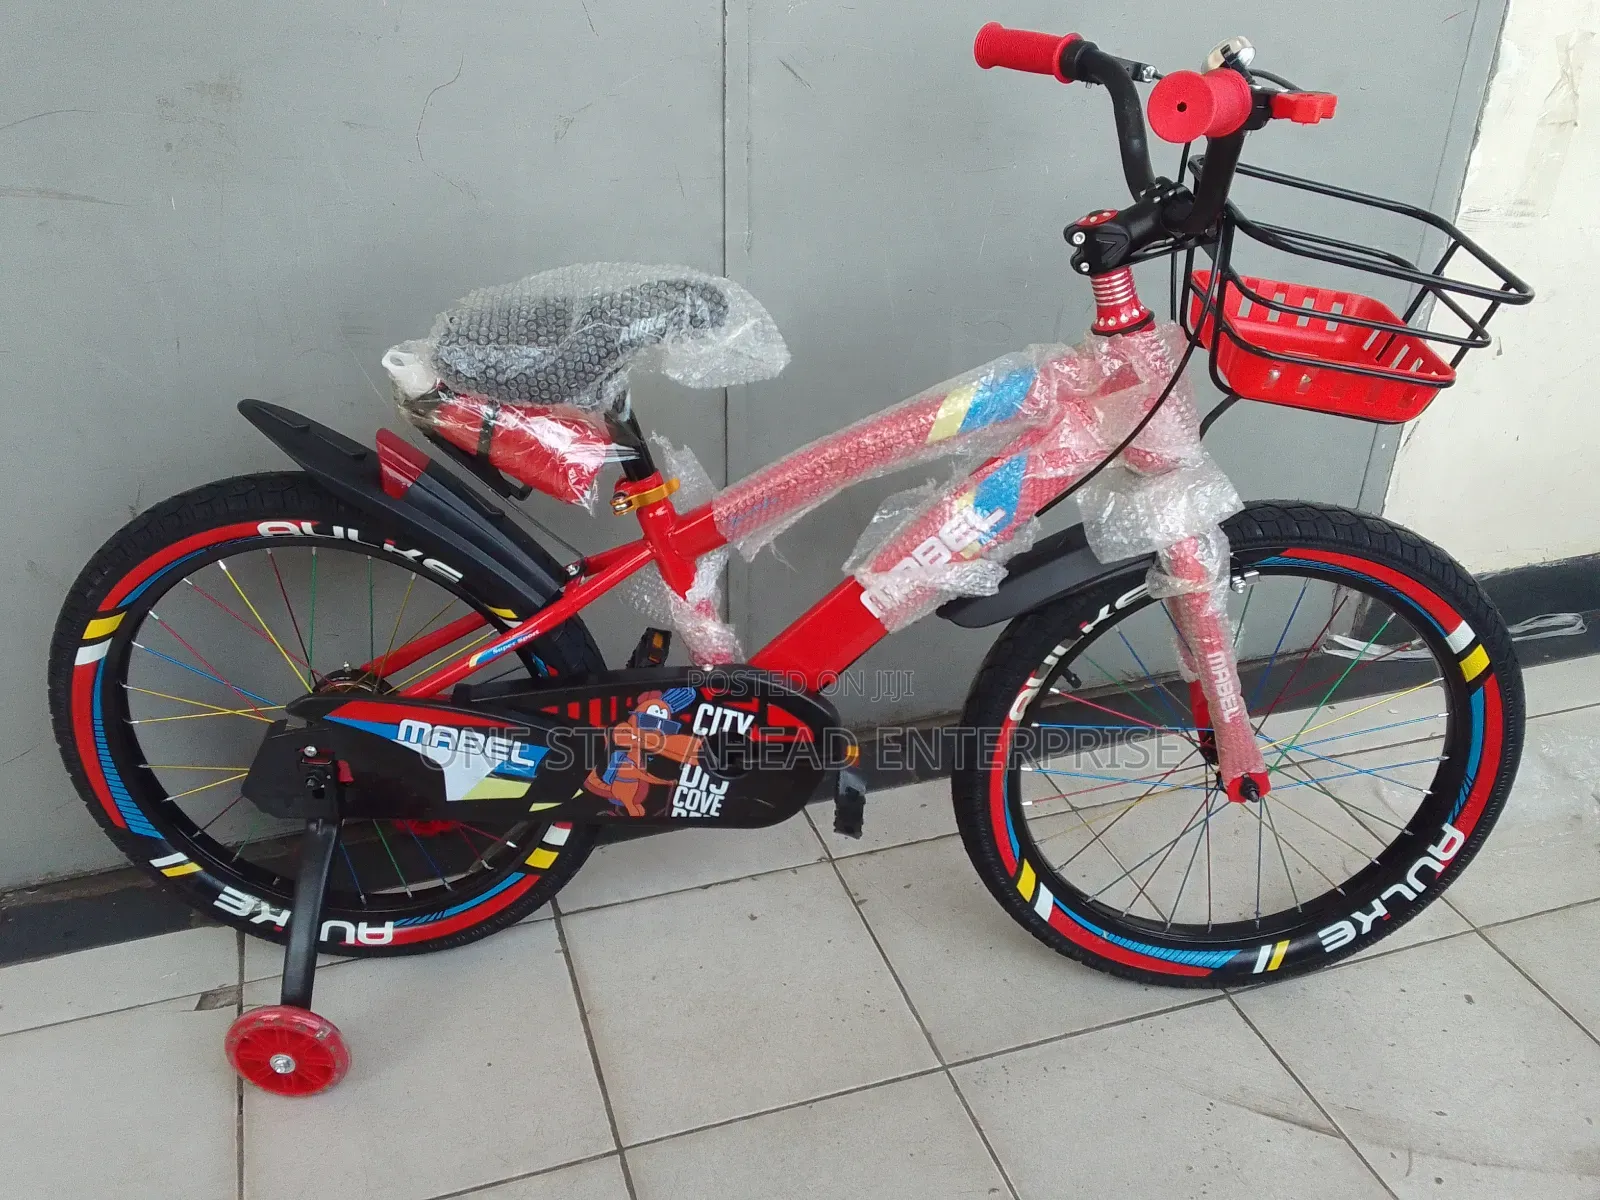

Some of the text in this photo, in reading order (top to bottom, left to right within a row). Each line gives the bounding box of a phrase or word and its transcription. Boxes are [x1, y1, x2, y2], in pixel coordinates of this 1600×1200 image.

[492, 641, 516, 655] Super
[1206, 652, 1242, 724] MABEL
[397, 718, 535, 768] MABEL
[692, 703, 755, 737] CITY
[1317, 822, 1466, 954] AULKE
[212, 886, 395, 946] AUKE
